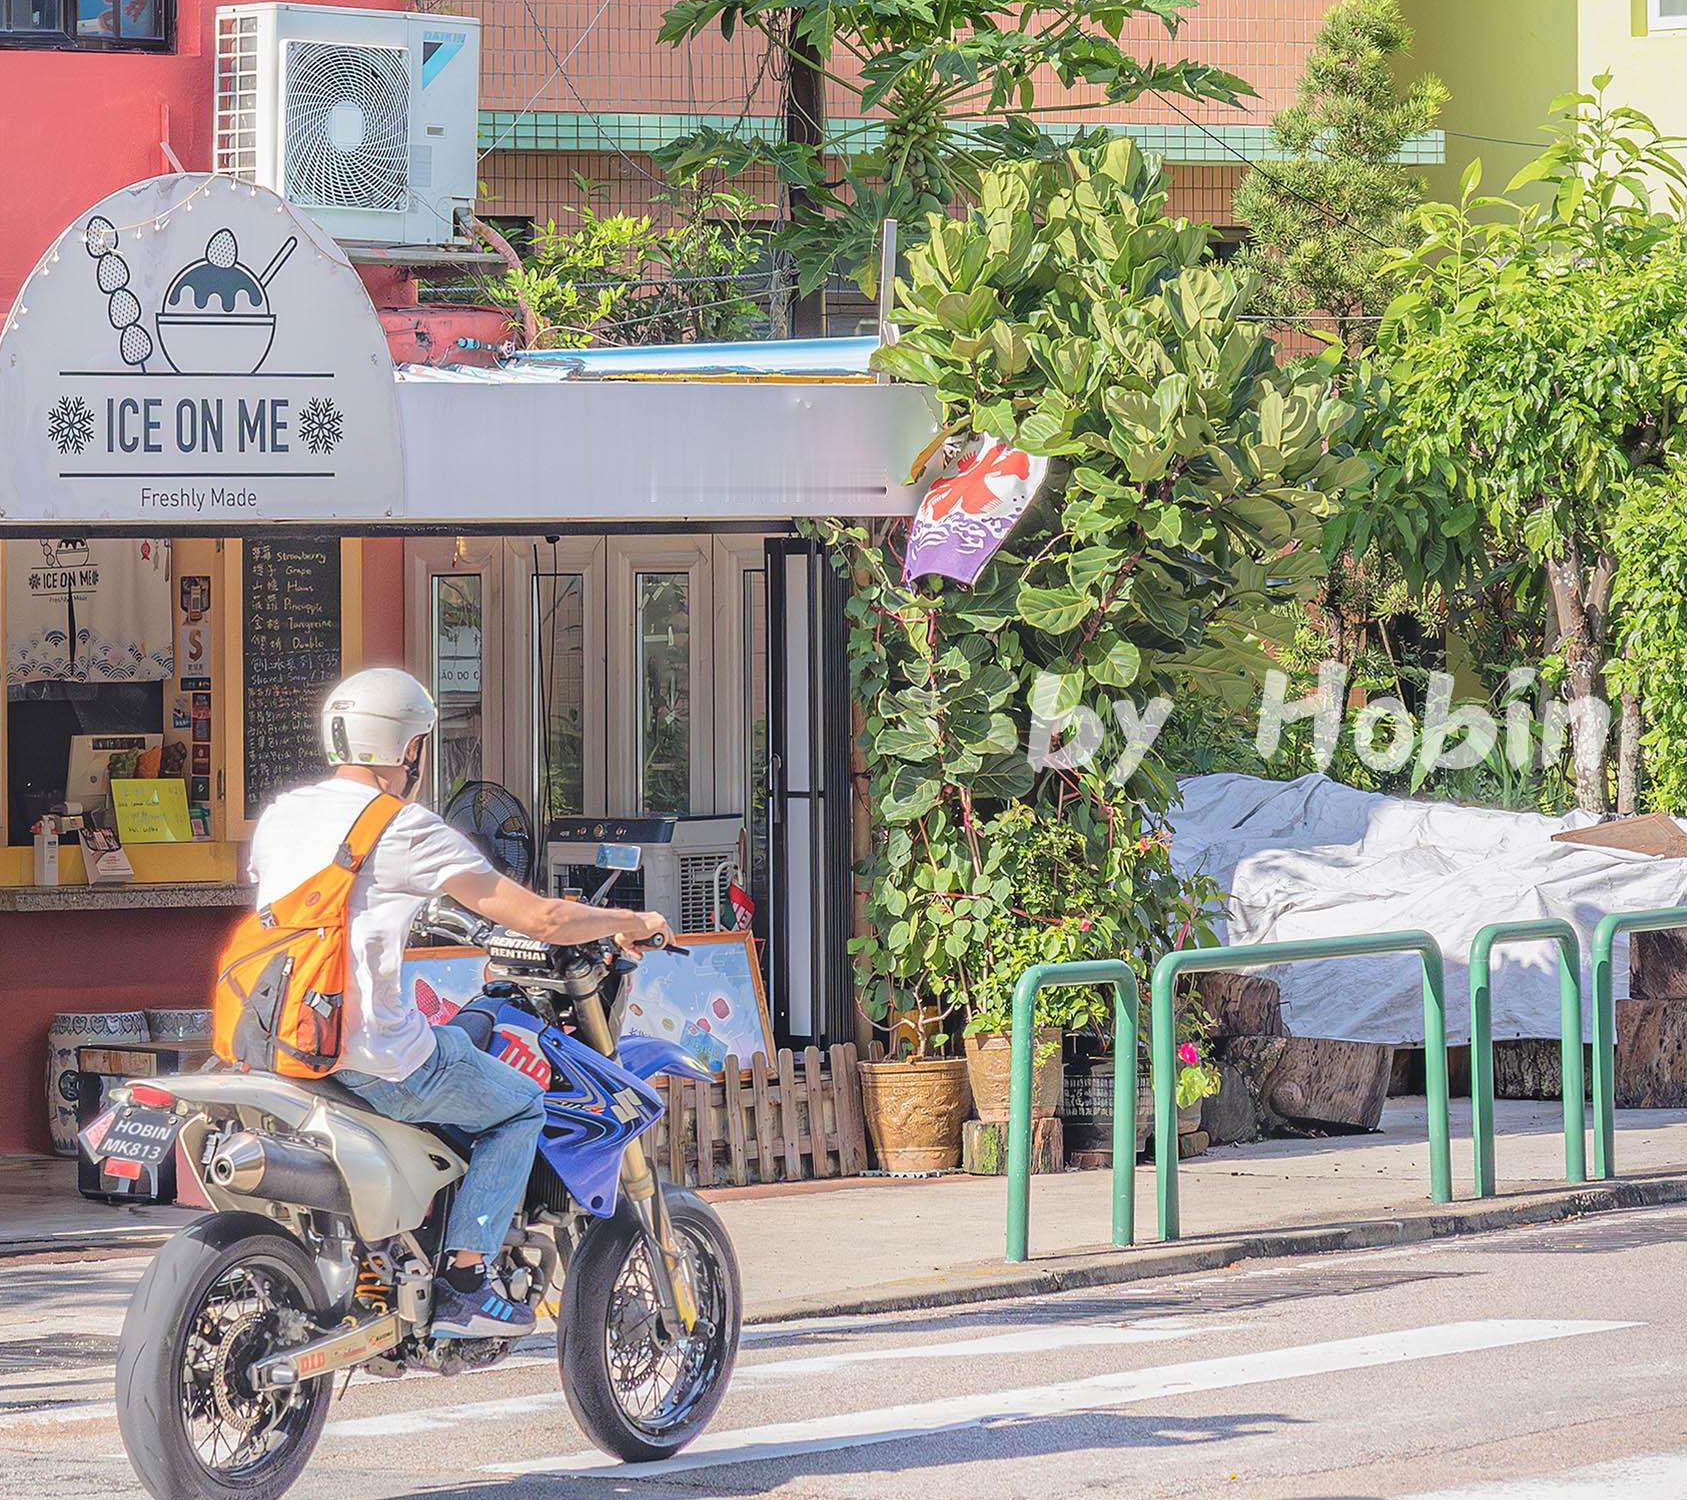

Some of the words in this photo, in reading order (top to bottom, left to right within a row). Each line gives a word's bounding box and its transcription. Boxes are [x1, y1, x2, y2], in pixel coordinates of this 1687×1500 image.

[107, 397, 162, 453] ICE
[175, 397, 223, 453] ON
[237, 397, 289, 453] ME
[140, 486, 204, 512] Freshly
[210, 486, 258, 508] Made
[276, 551, 326, 564] Strawberry
[43, 573, 57, 589] ICE
[60, 572, 76, 588] ON
[80, 571, 92, 586] ME
[457, 671, 469, 680] DO
[114, 1119, 172, 1141] HOBIN
[102, 1138, 161, 1160] MK813
